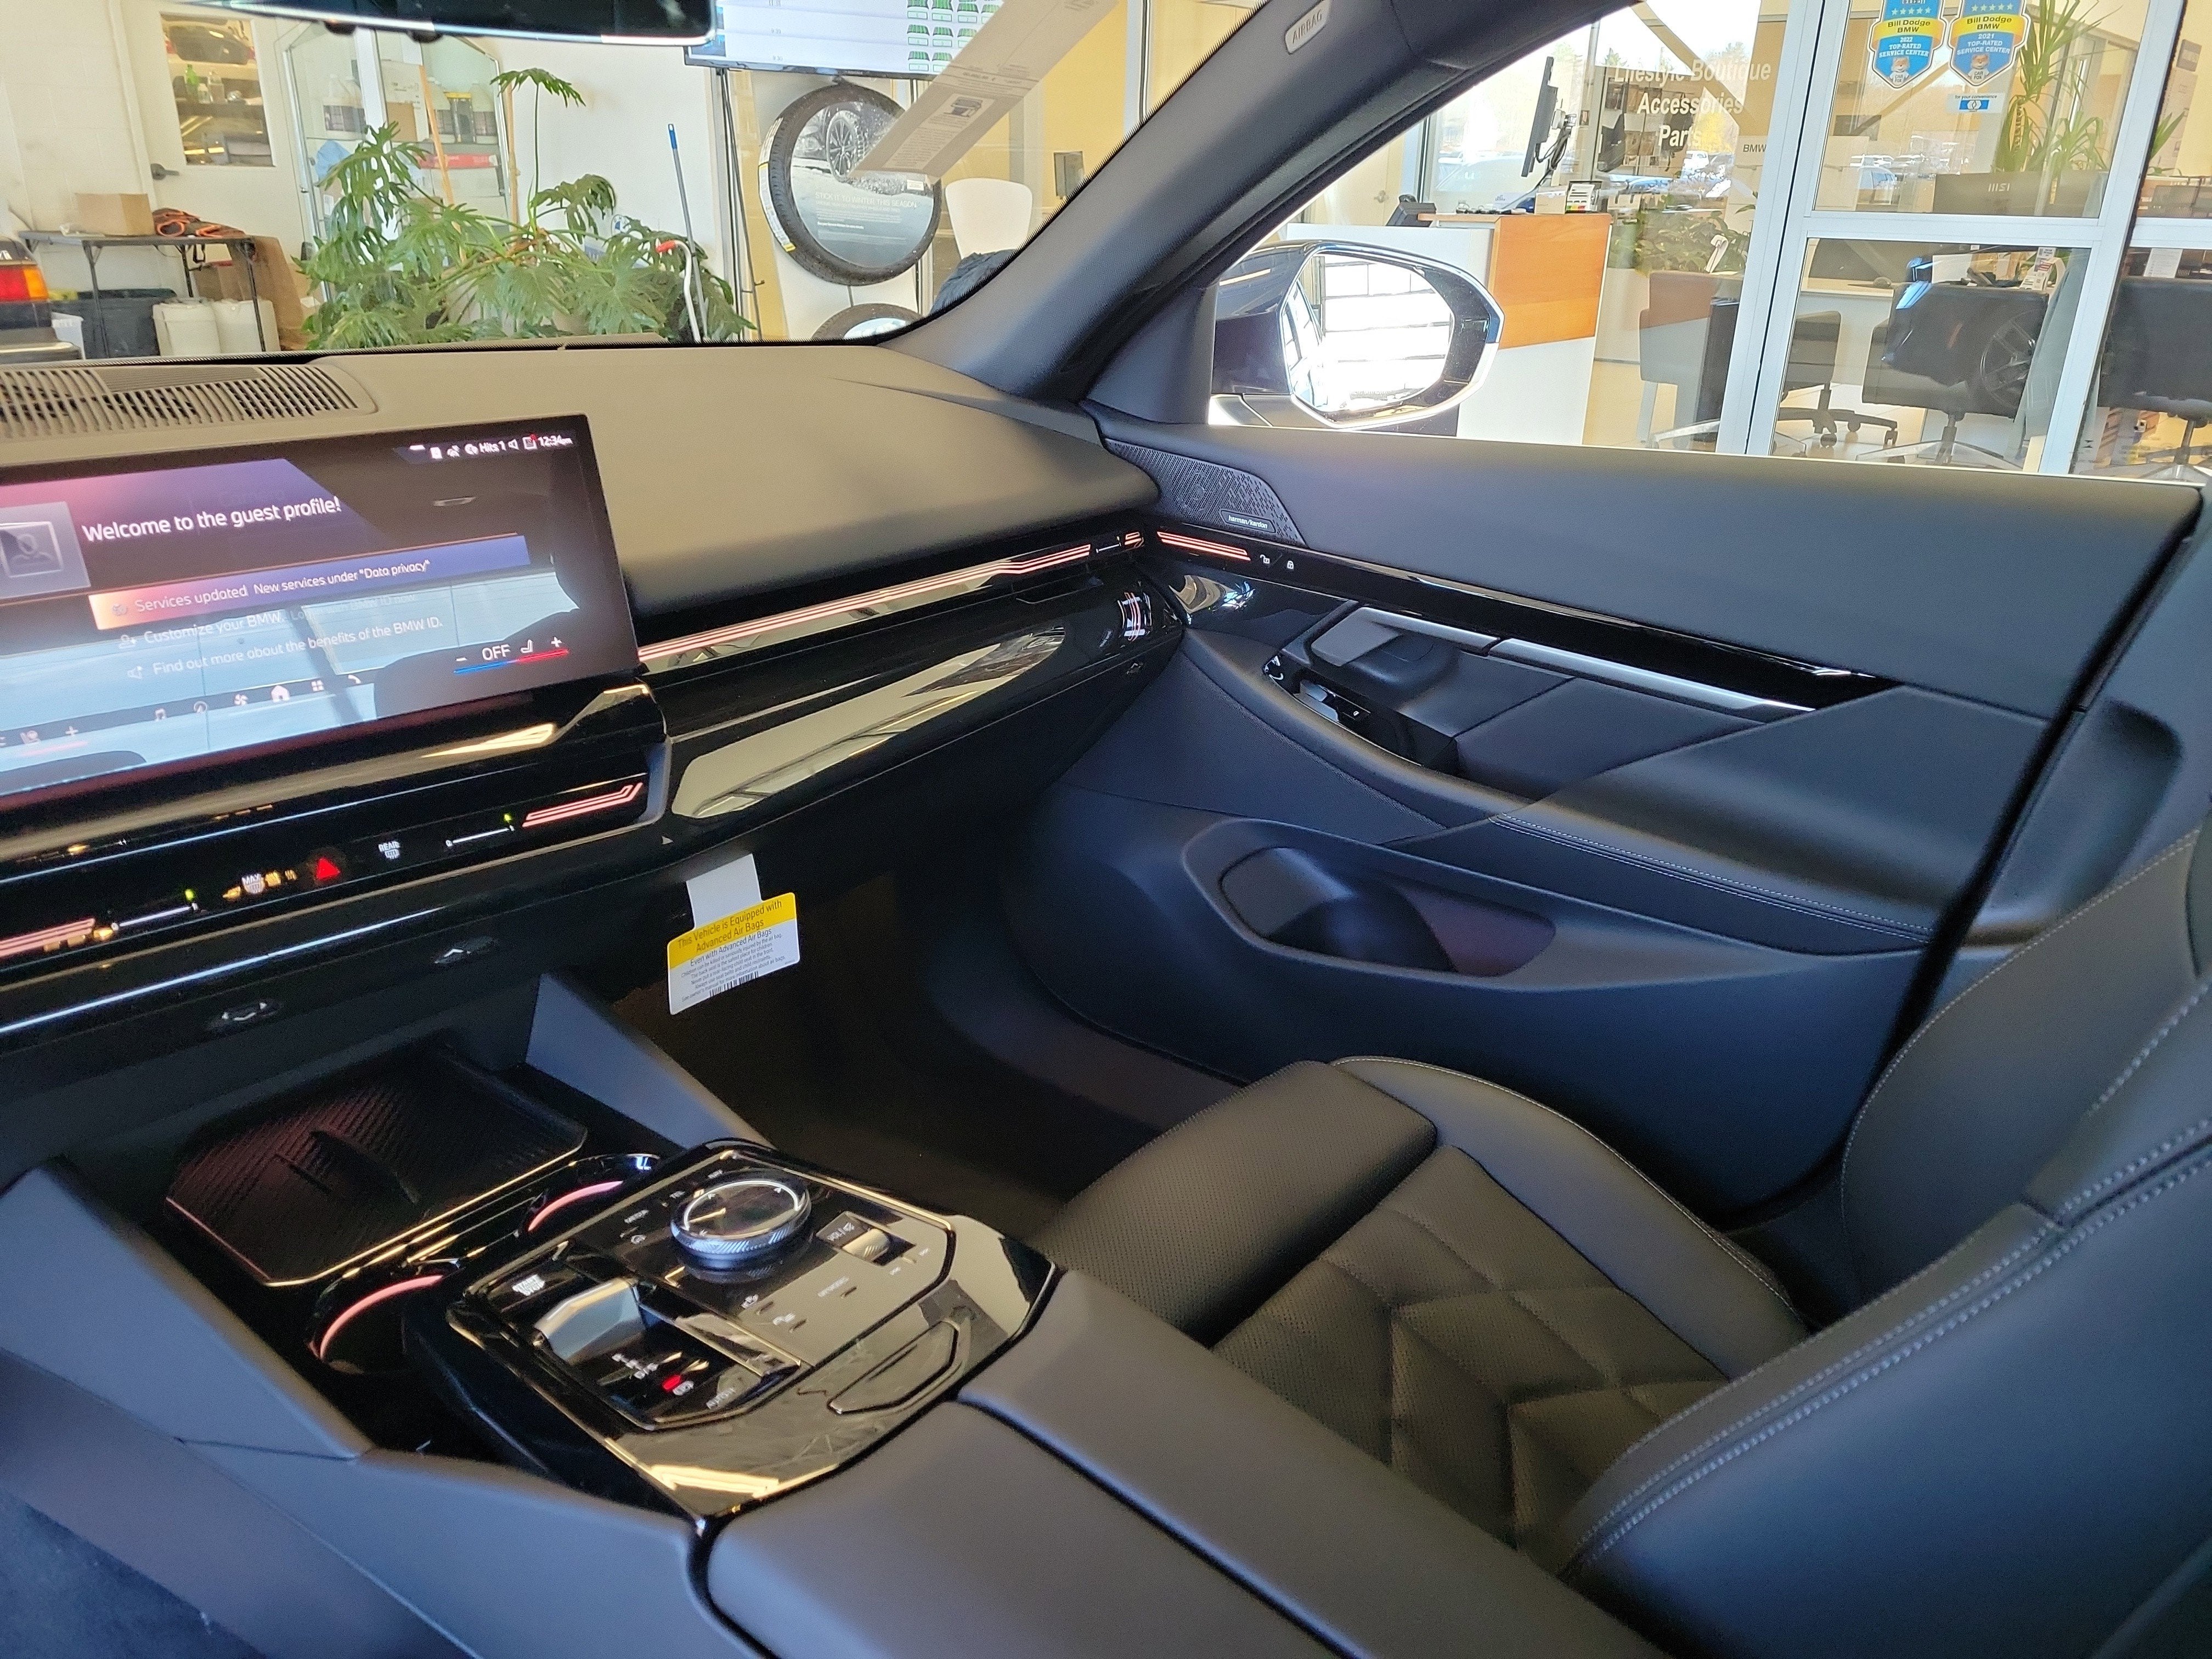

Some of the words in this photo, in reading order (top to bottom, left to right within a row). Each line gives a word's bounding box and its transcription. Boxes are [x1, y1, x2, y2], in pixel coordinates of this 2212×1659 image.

[1637, 92, 1745, 115] Accessories
[1658, 125, 1703, 148] Parts
[1743, 143, 1768, 153] BMW
[478, 442, 499, 453] Hits
[82, 519, 171, 542] Welcome
[174, 515, 194, 531] to
[197, 510, 228, 529] the
[231, 504, 280, 528] guest
[283, 495, 342, 521] profile!
[1228, 515, 1268, 528] harman/kardon
[253, 583, 280, 595] New
[281, 575, 326, 591] services
[327, 571, 358, 585] under
[359, 566, 390, 579] "Data
[391, 559, 431, 577] privacy"
[134, 595, 191, 612] Services
[194, 584, 249, 604] updated
[143, 623, 213, 644] Customize
[215, 619, 244, 636] your
[246, 611, 284, 628] BMW.
[153, 660, 183, 674] Find
[186, 657, 208, 670] out
[210, 651, 243, 665] more
[246, 644, 284, 659] about
[286, 638, 306, 653] the
[307, 632, 356, 648] benefits
[358, 628, 371, 641] of
[372, 625, 391, 638] the
[393, 618, 425, 634] BMW
[427, 616, 443, 629] ID.
[482, 644, 511, 661] OFF
[378, 840, 401, 852] REAR
[678, 936, 692, 949] This
[693, 924, 720, 941] Vehicle
[722, 919, 729, 929] is
[730, 906, 765, 926] Equipped
[765, 900, 782, 912] with
[696, 932, 732, 953] Advanced
[733, 926, 743, 936] Air
[745, 918, 764, 932] Bags
[690, 955, 705, 967] Even
[705, 949, 718, 960] with
[719, 936, 747, 953] Advanced
[748, 932, 757, 942] Air
[757, 928, 772, 939] Bags
